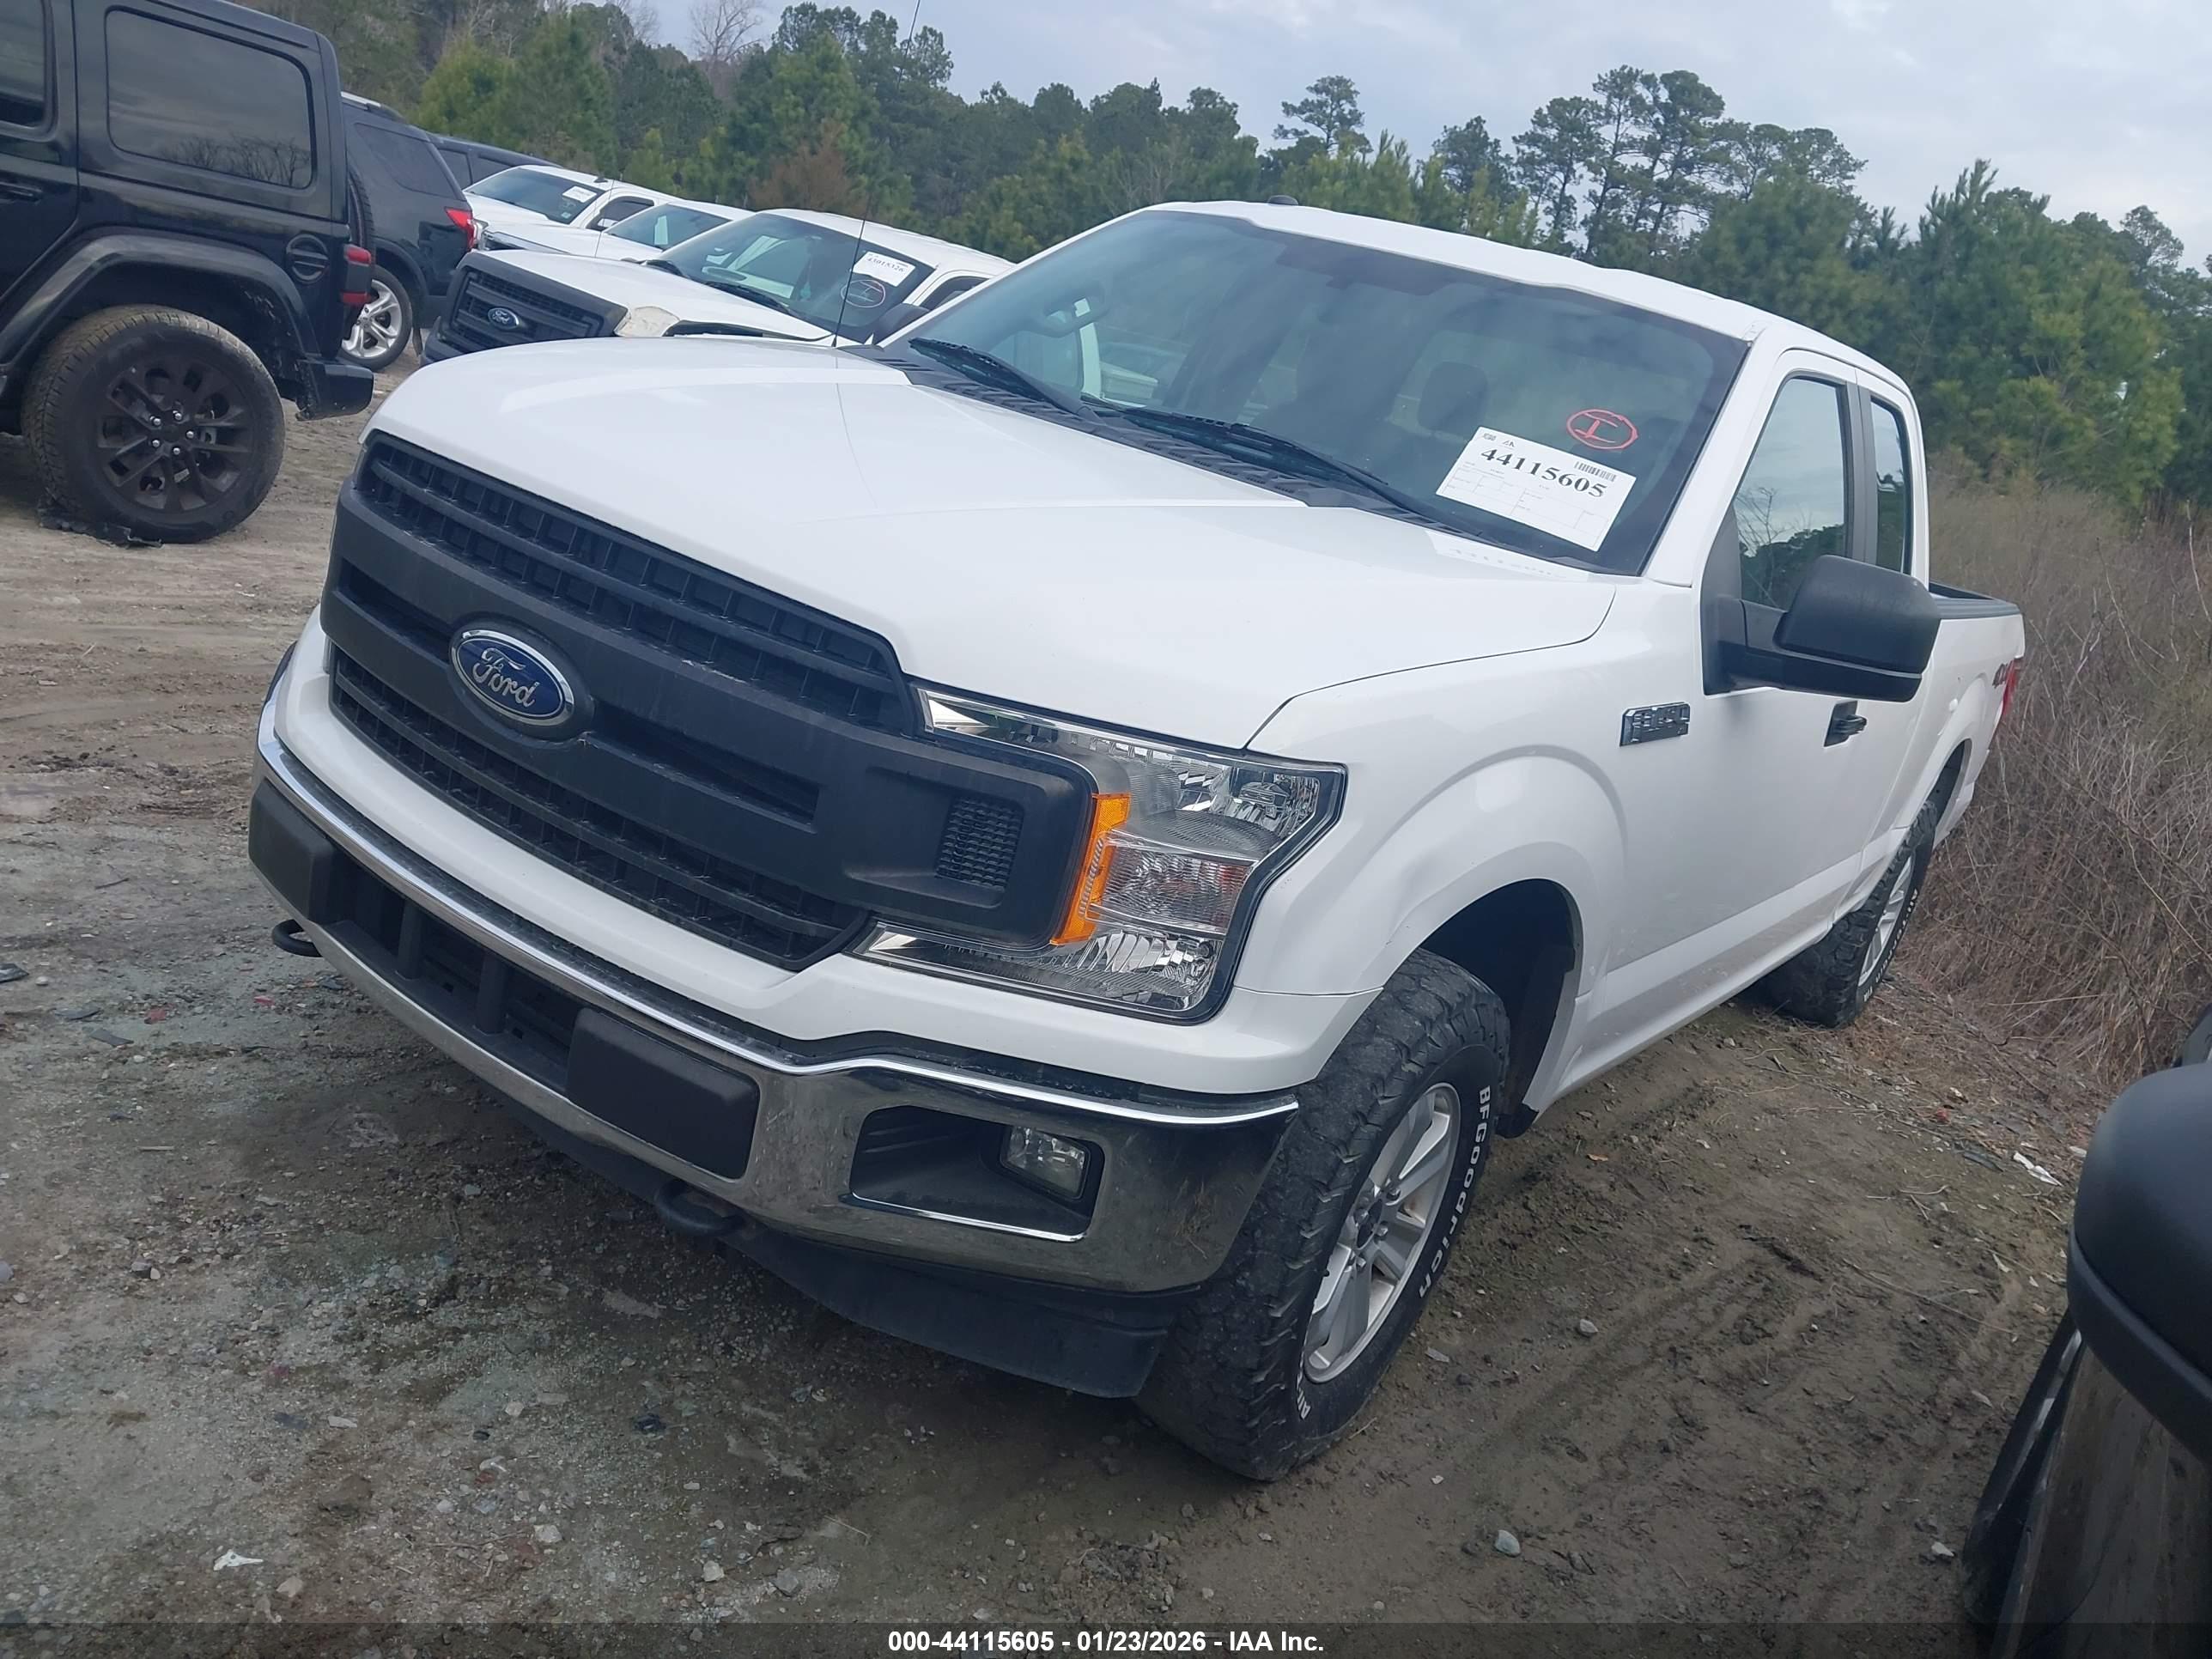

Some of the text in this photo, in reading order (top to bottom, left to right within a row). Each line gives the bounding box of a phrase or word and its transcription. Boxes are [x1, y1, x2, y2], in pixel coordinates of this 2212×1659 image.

[492, 310, 510, 325] Ford
[1480, 449, 1607, 498] 44115605
[471, 647, 540, 708] Ford
